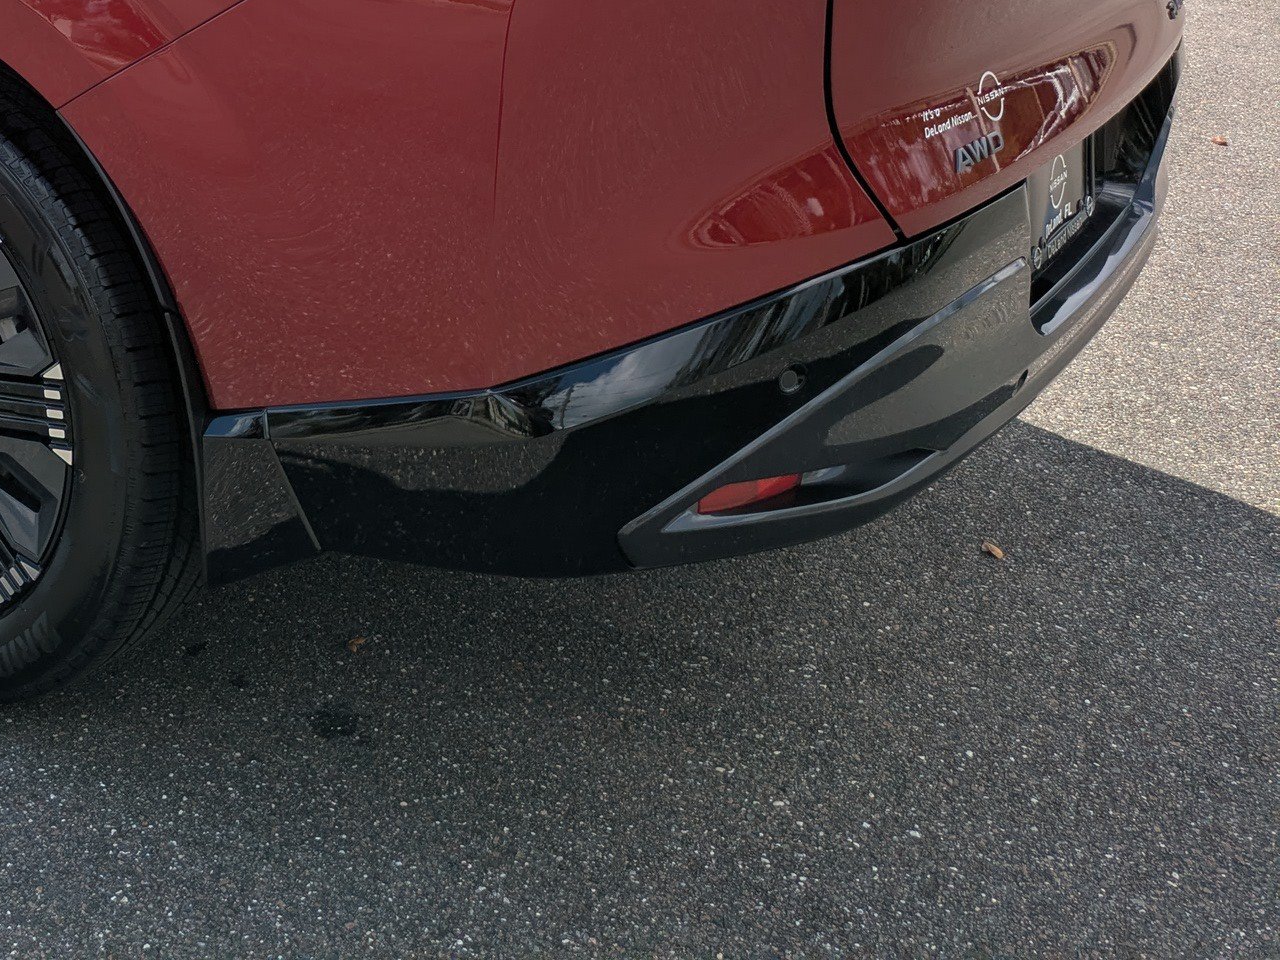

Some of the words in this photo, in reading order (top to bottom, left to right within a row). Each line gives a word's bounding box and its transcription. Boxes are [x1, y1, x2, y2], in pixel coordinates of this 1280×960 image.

[977, 88, 1004, 106] NISSAN
[924, 118, 951, 139] DeLand
[954, 130, 1005, 174] AWD
